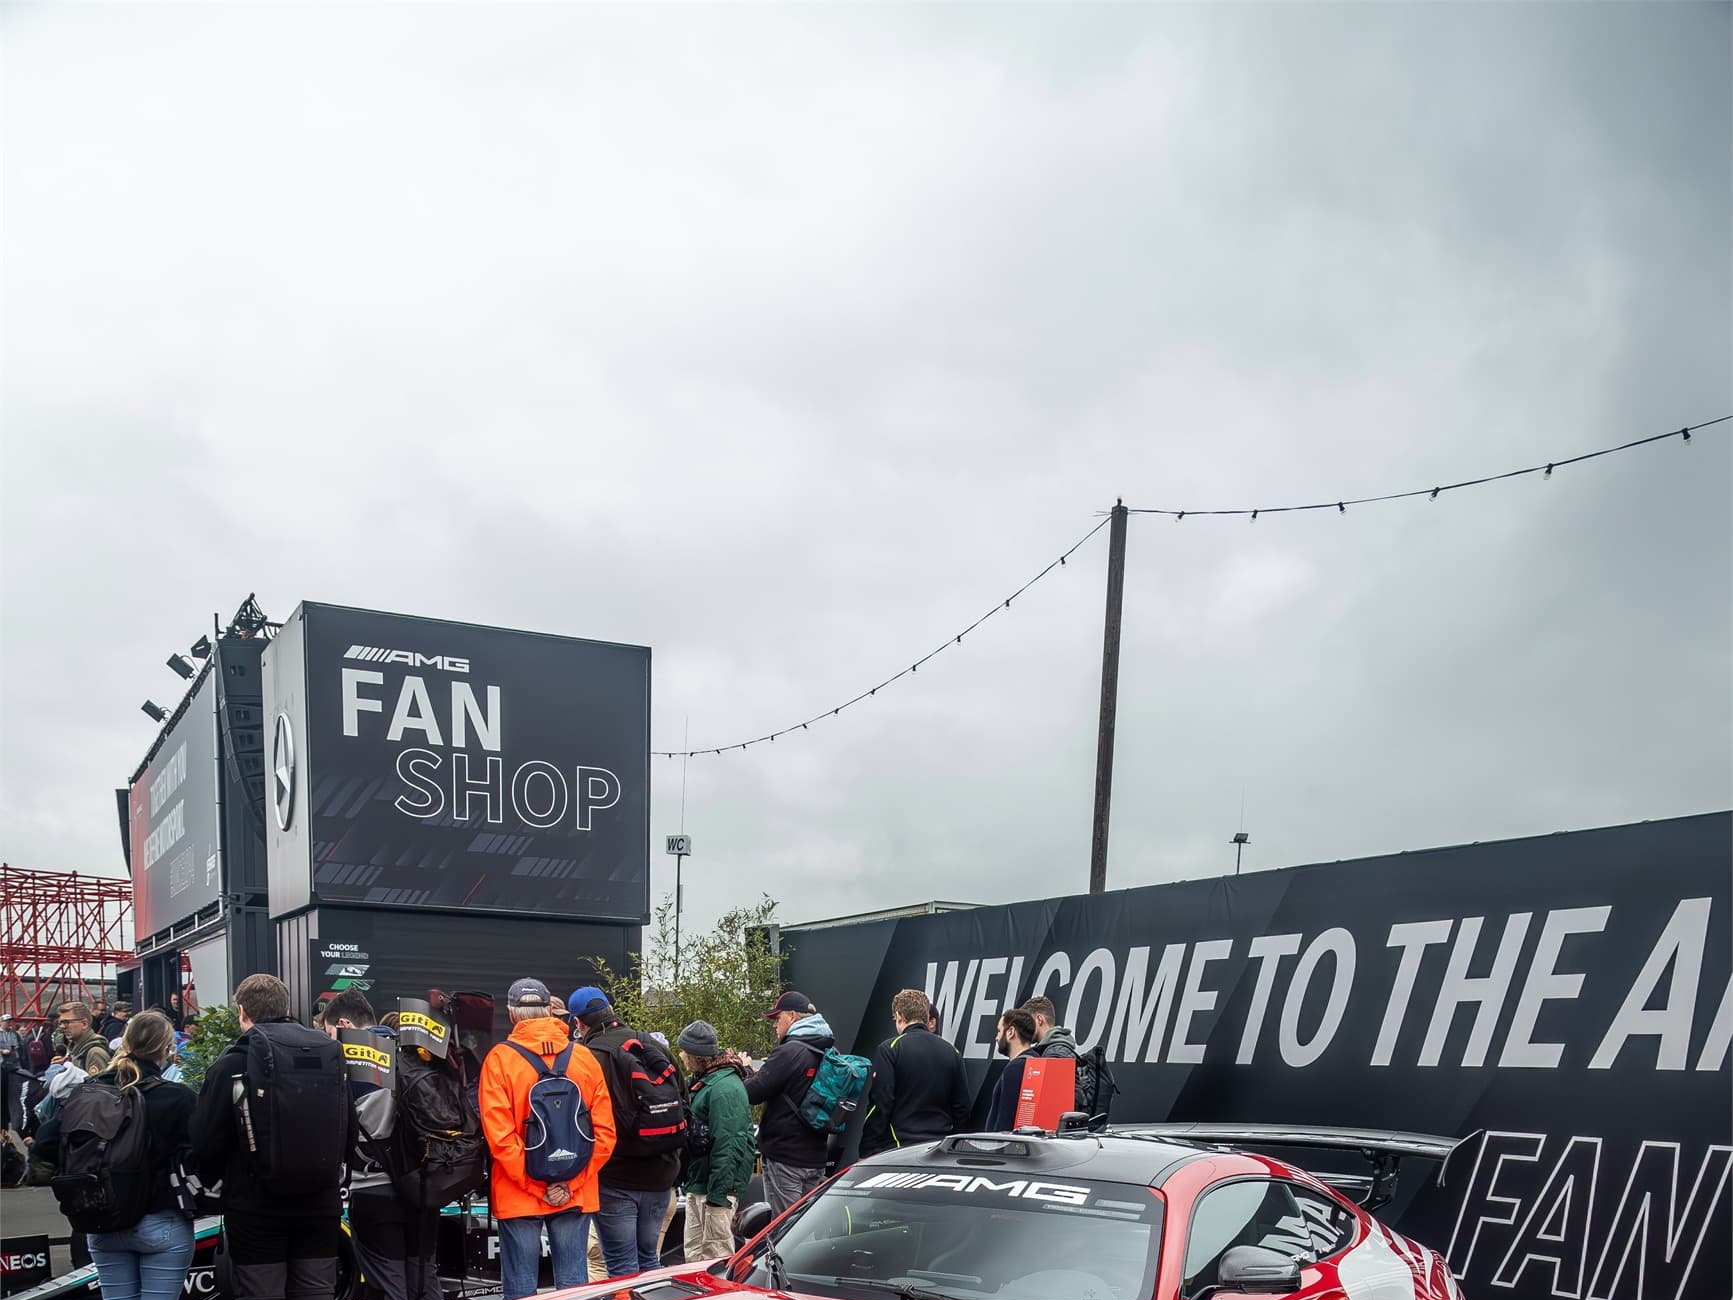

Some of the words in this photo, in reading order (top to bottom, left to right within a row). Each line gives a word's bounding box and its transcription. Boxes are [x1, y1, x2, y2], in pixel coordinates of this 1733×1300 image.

[385, 649, 470, 673] AMG
[342, 668, 501, 751] FAN
[395, 748, 621, 831] SHOP
[667, 838, 685, 851] WC
[320, 950, 341, 958] YOUR
[328, 943, 359, 952] CHOOSE
[1235, 927, 1357, 1068] TO
[1369, 905, 1613, 1069] THE
[1587, 897, 1733, 1071] A
[400, 1014, 429, 1028] Giti
[345, 1047, 376, 1062] Giti
[910, 1174, 1091, 1205] AMG
